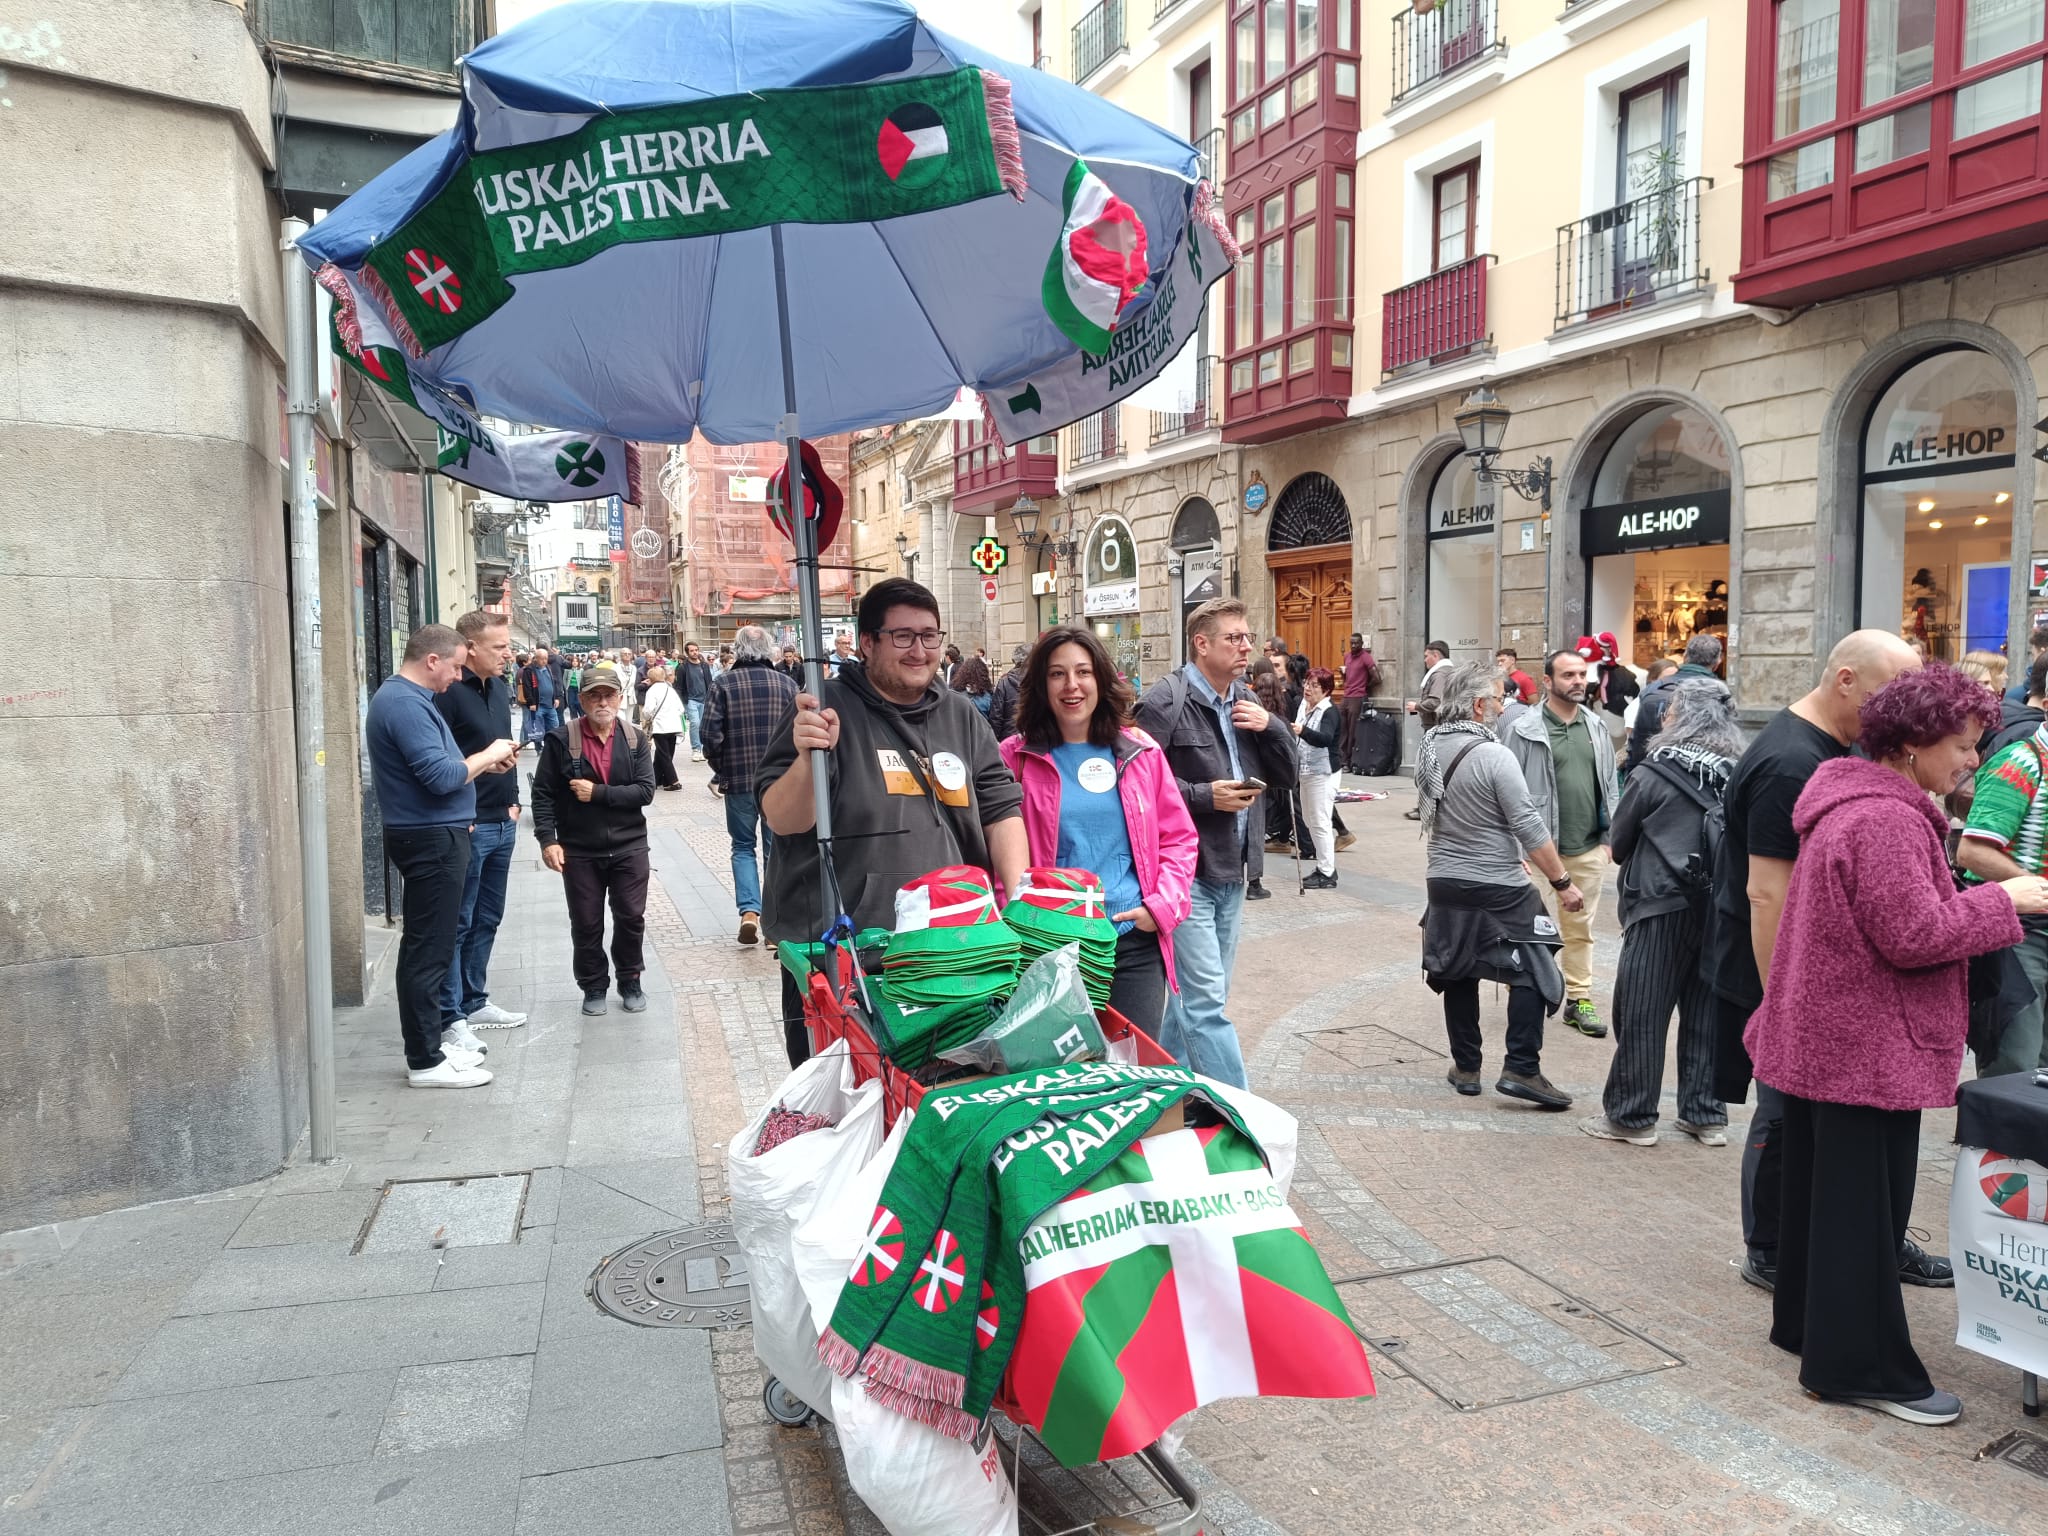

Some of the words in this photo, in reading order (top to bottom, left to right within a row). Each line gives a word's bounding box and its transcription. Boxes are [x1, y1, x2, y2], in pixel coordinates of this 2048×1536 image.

[601, 118, 771, 180] HERRIA
[507, 172, 731, 254] PALESTINA
[1888, 427, 2006, 466] ALE-HOP
[1618, 506, 1700, 537] ALE-HOP
[1458, 638, 1479, 646] ALE-HOP
[1140, 1193, 1237, 1225] ERABAKI
